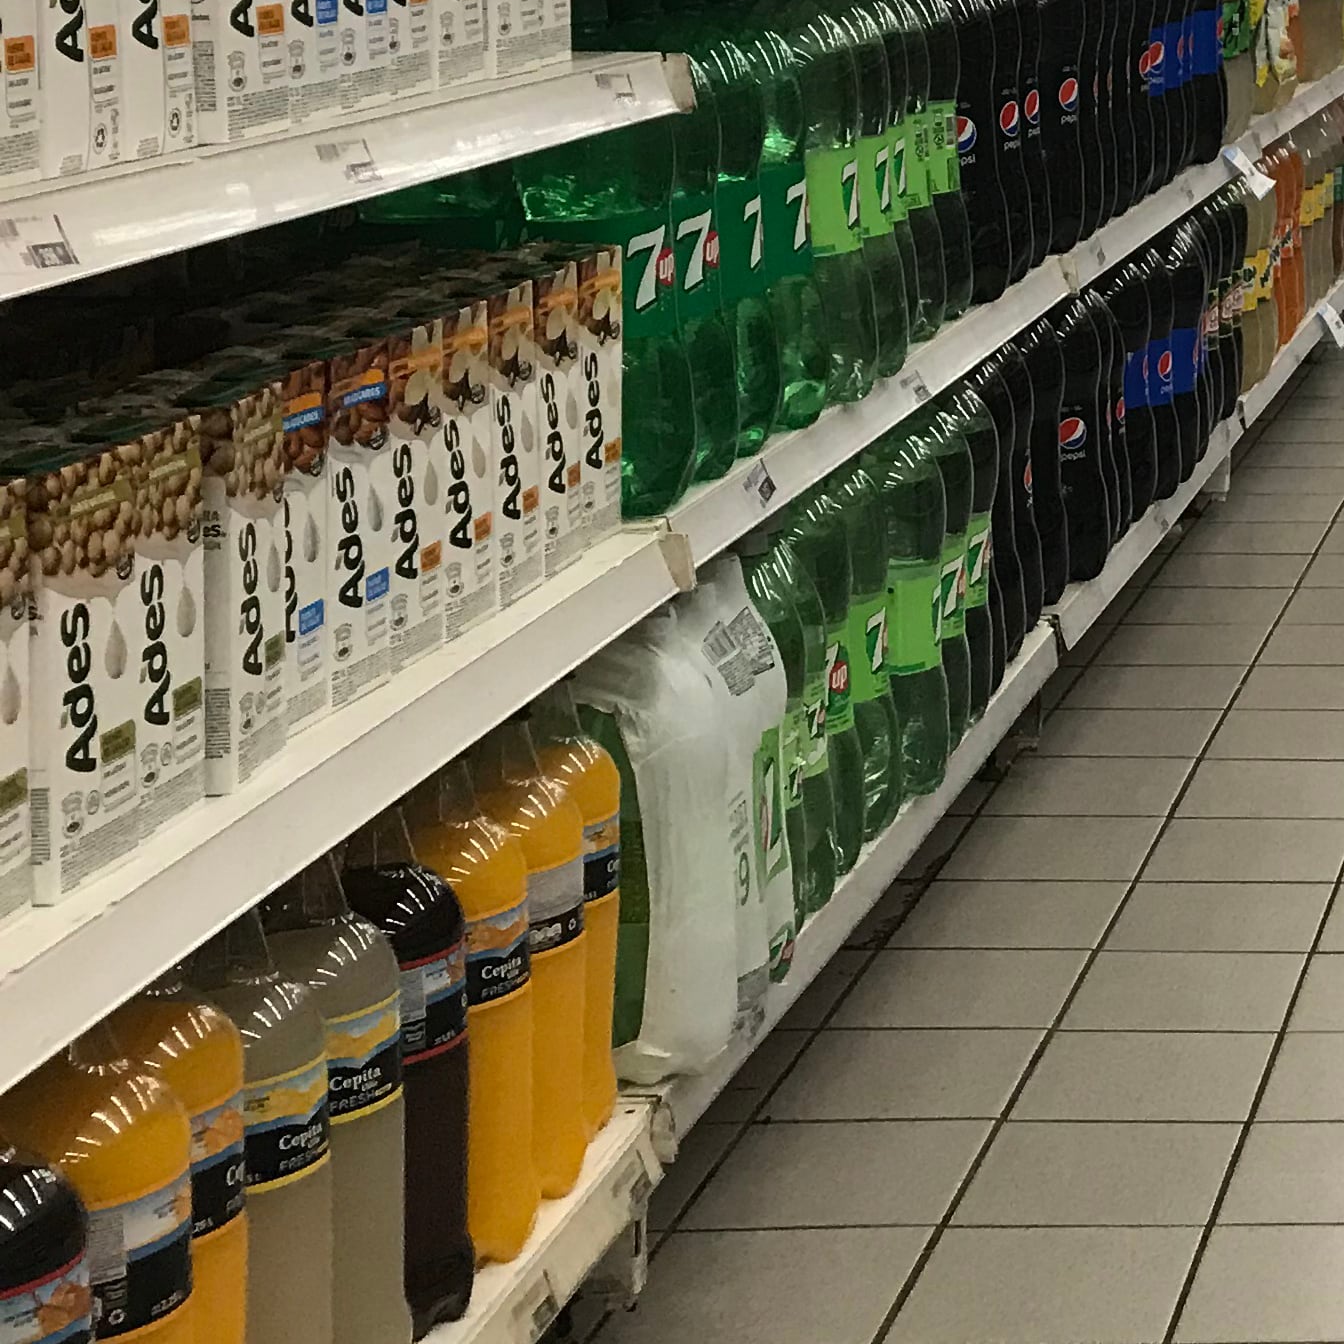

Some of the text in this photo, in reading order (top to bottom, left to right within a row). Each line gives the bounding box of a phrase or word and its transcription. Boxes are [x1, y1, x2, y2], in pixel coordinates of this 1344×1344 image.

[677, 209, 712, 292] 7
[627, 225, 666, 311] 7
[481, 956, 523, 980] Cepita
[329, 1066, 382, 1092] Cepita
[279, 1123, 323, 1150] Cepita
